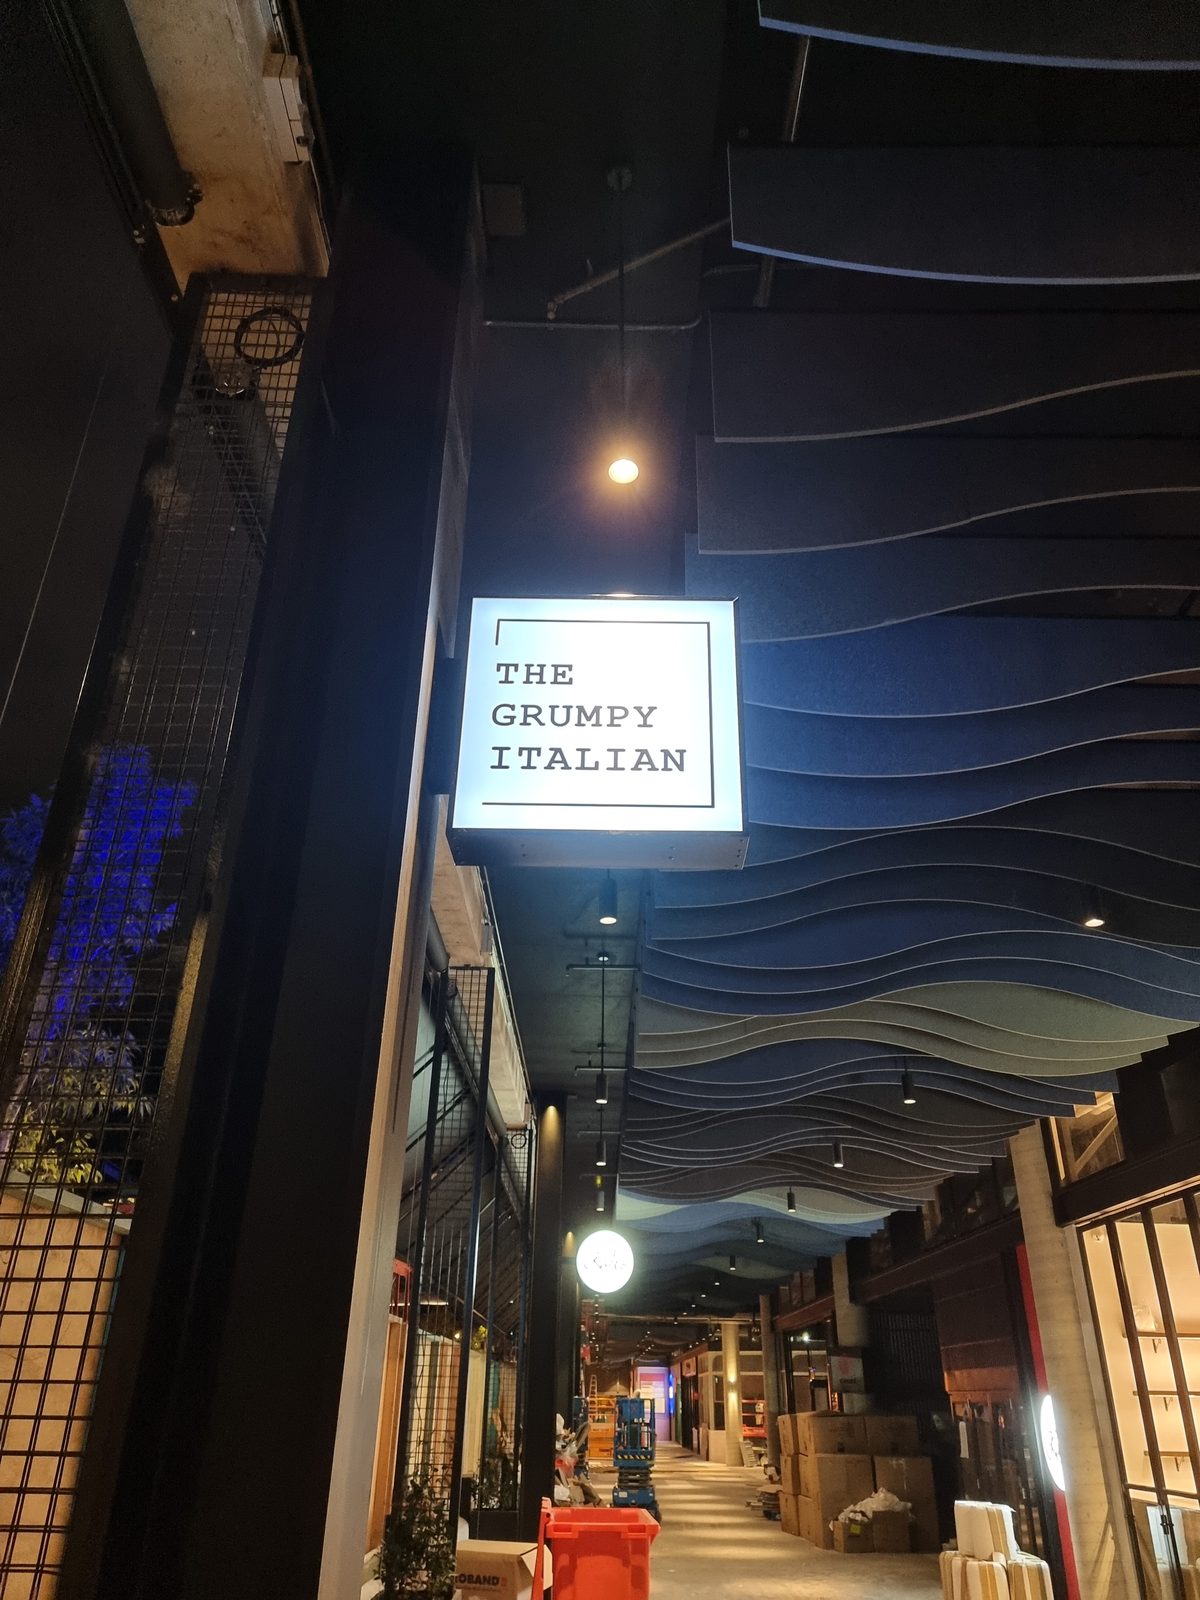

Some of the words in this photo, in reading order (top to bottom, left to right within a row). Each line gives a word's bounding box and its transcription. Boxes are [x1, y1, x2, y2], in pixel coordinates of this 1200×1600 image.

[496, 663, 573, 685] THE
[492, 703, 657, 728] GRUMPY
[490, 746, 687, 772] ITALIAN
